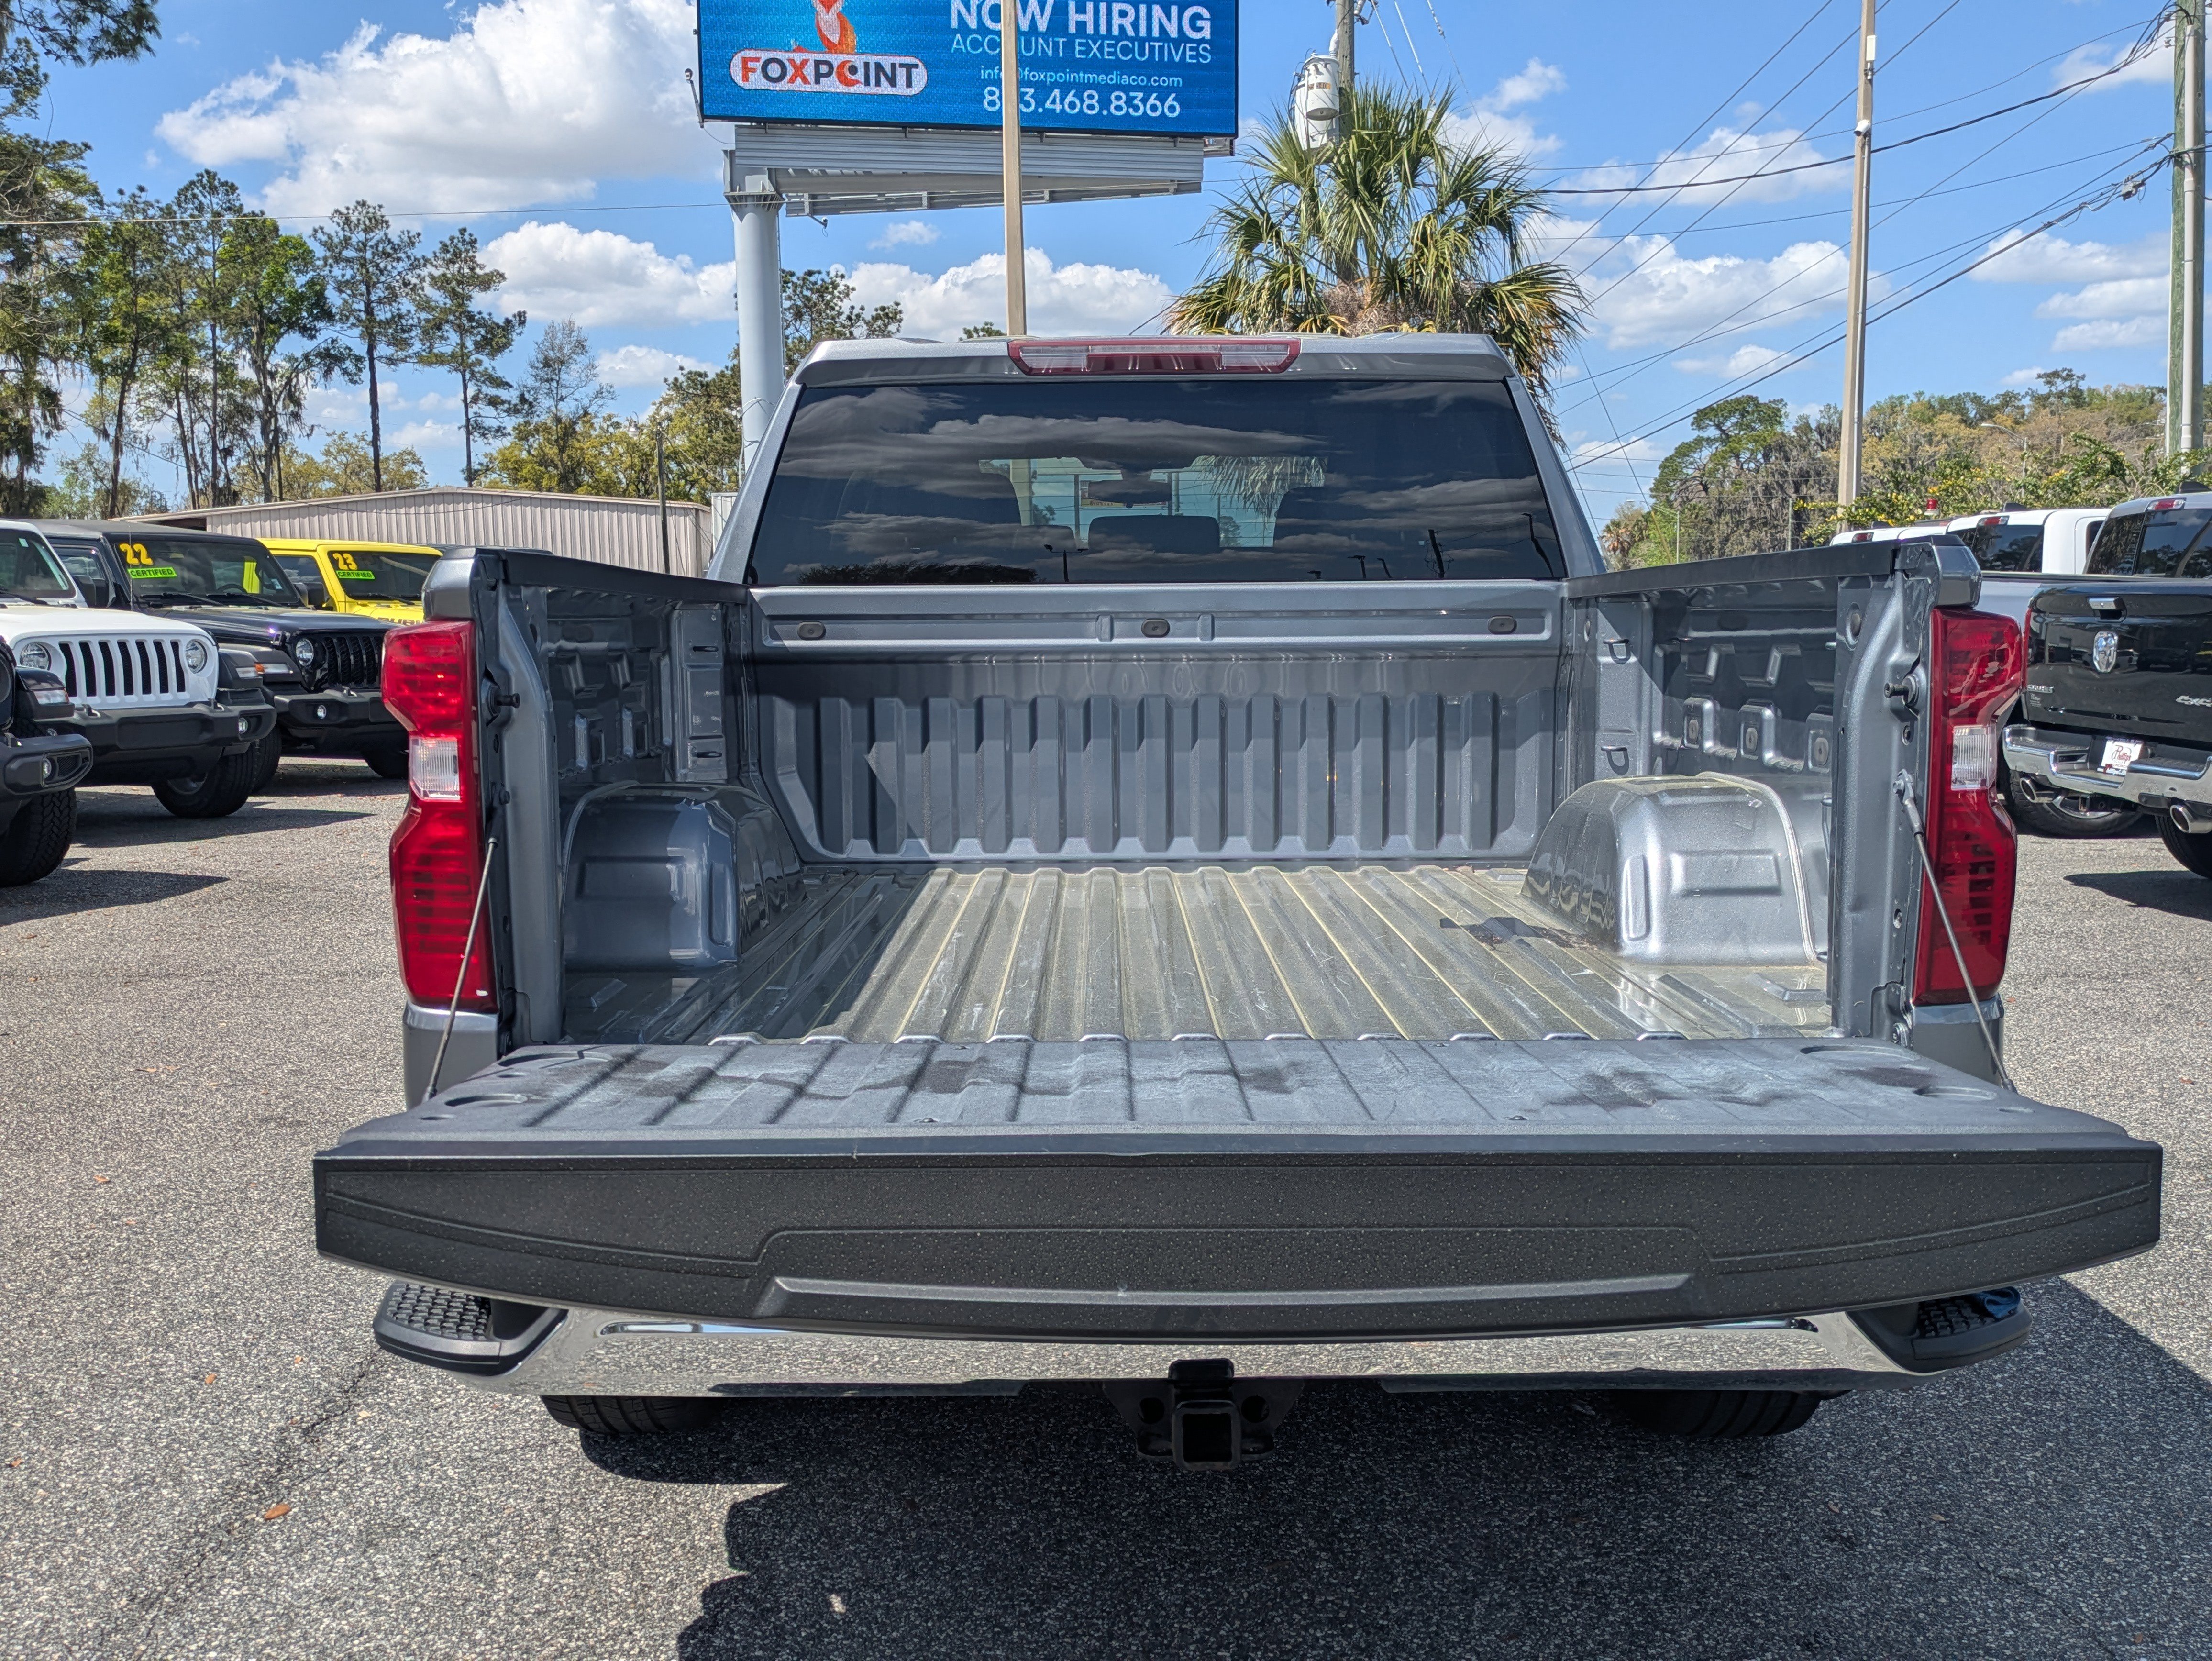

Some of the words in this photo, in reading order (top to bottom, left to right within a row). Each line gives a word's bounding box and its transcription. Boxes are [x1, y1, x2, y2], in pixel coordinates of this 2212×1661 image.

[1068, 0, 1211, 40] HIRING
[951, 33, 1067, 57] ACCUNT
[1075, 38, 1212, 64] EXECUTIVES
[741, 56, 919, 88] FOXPOINT
[981, 65, 1183, 87] inffoxpointmediaco.com
[983, 86, 1181, 118] 83.468.8366
[119, 543, 154, 565] 22
[332, 553, 358, 570] 23
[130, 568, 173, 576] CERTIFIED
